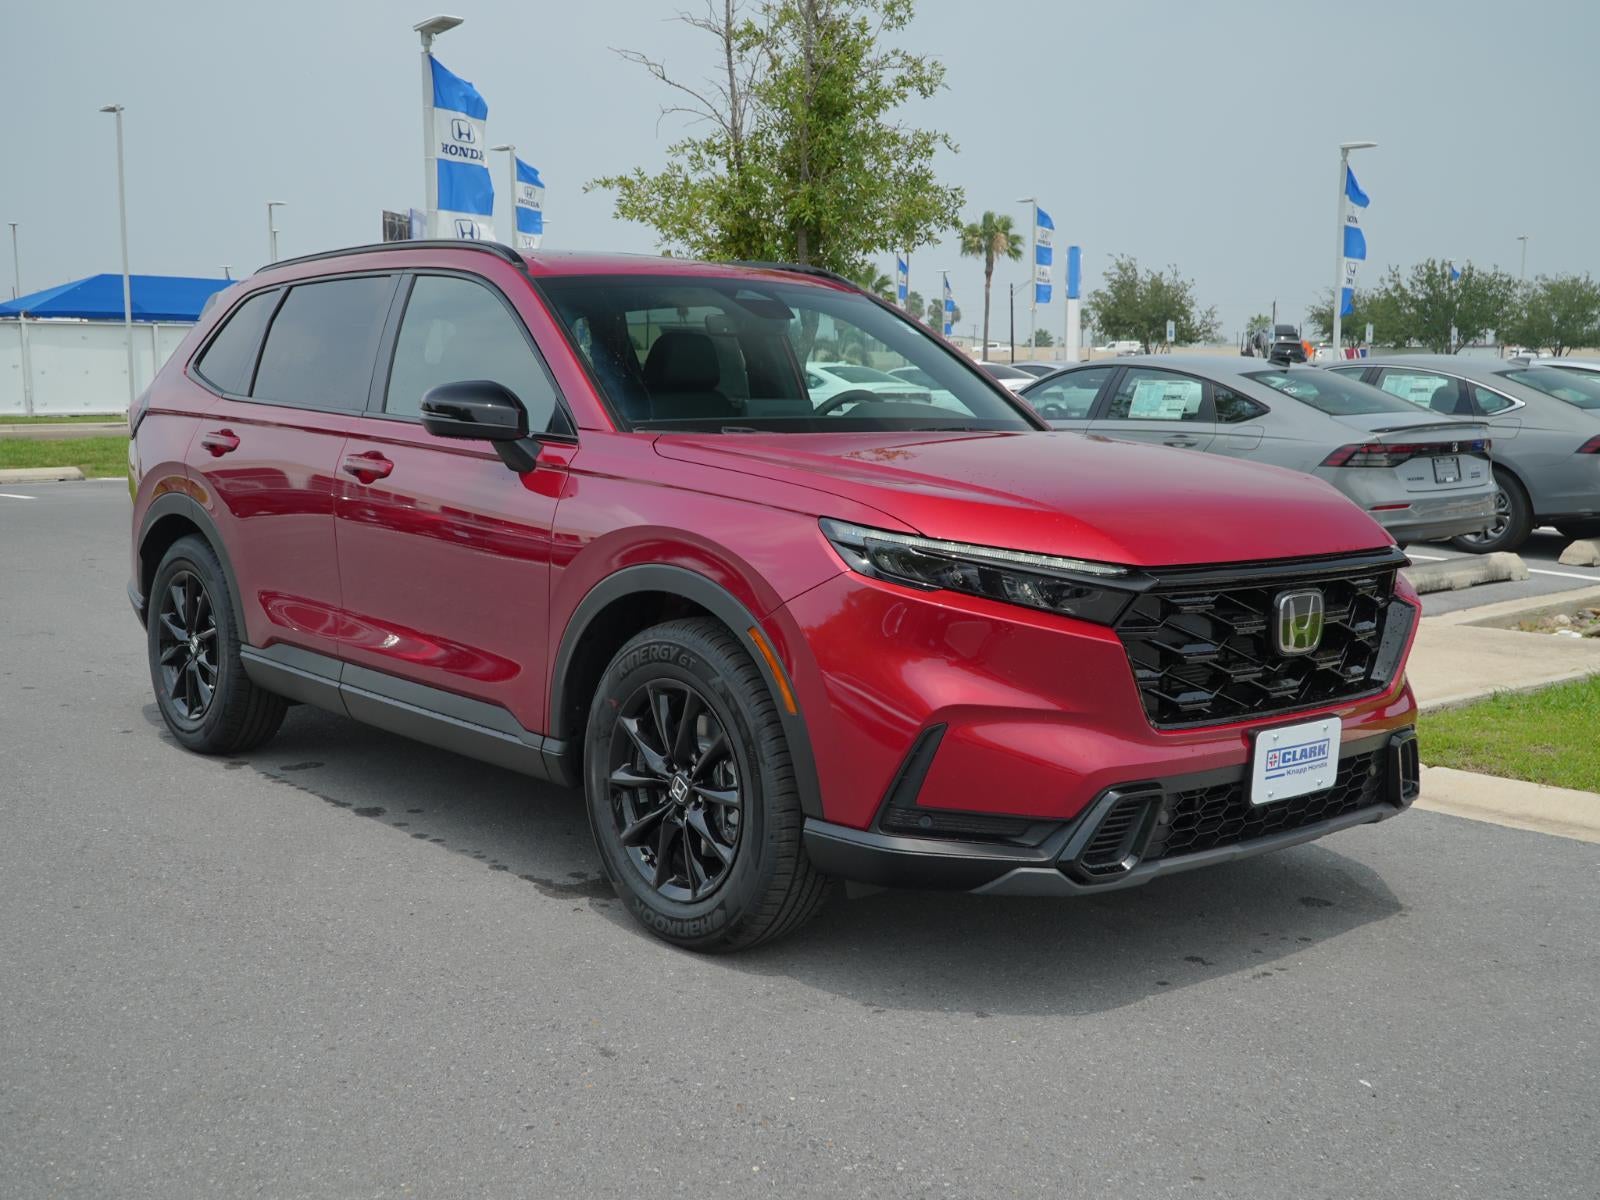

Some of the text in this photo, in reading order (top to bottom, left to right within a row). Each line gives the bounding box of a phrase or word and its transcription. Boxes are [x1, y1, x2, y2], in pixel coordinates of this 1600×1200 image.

[678, 653, 697, 670] GT
[1281, 744, 1327, 764] CLARK
[1286, 762, 1328, 776] Knapp Honda
